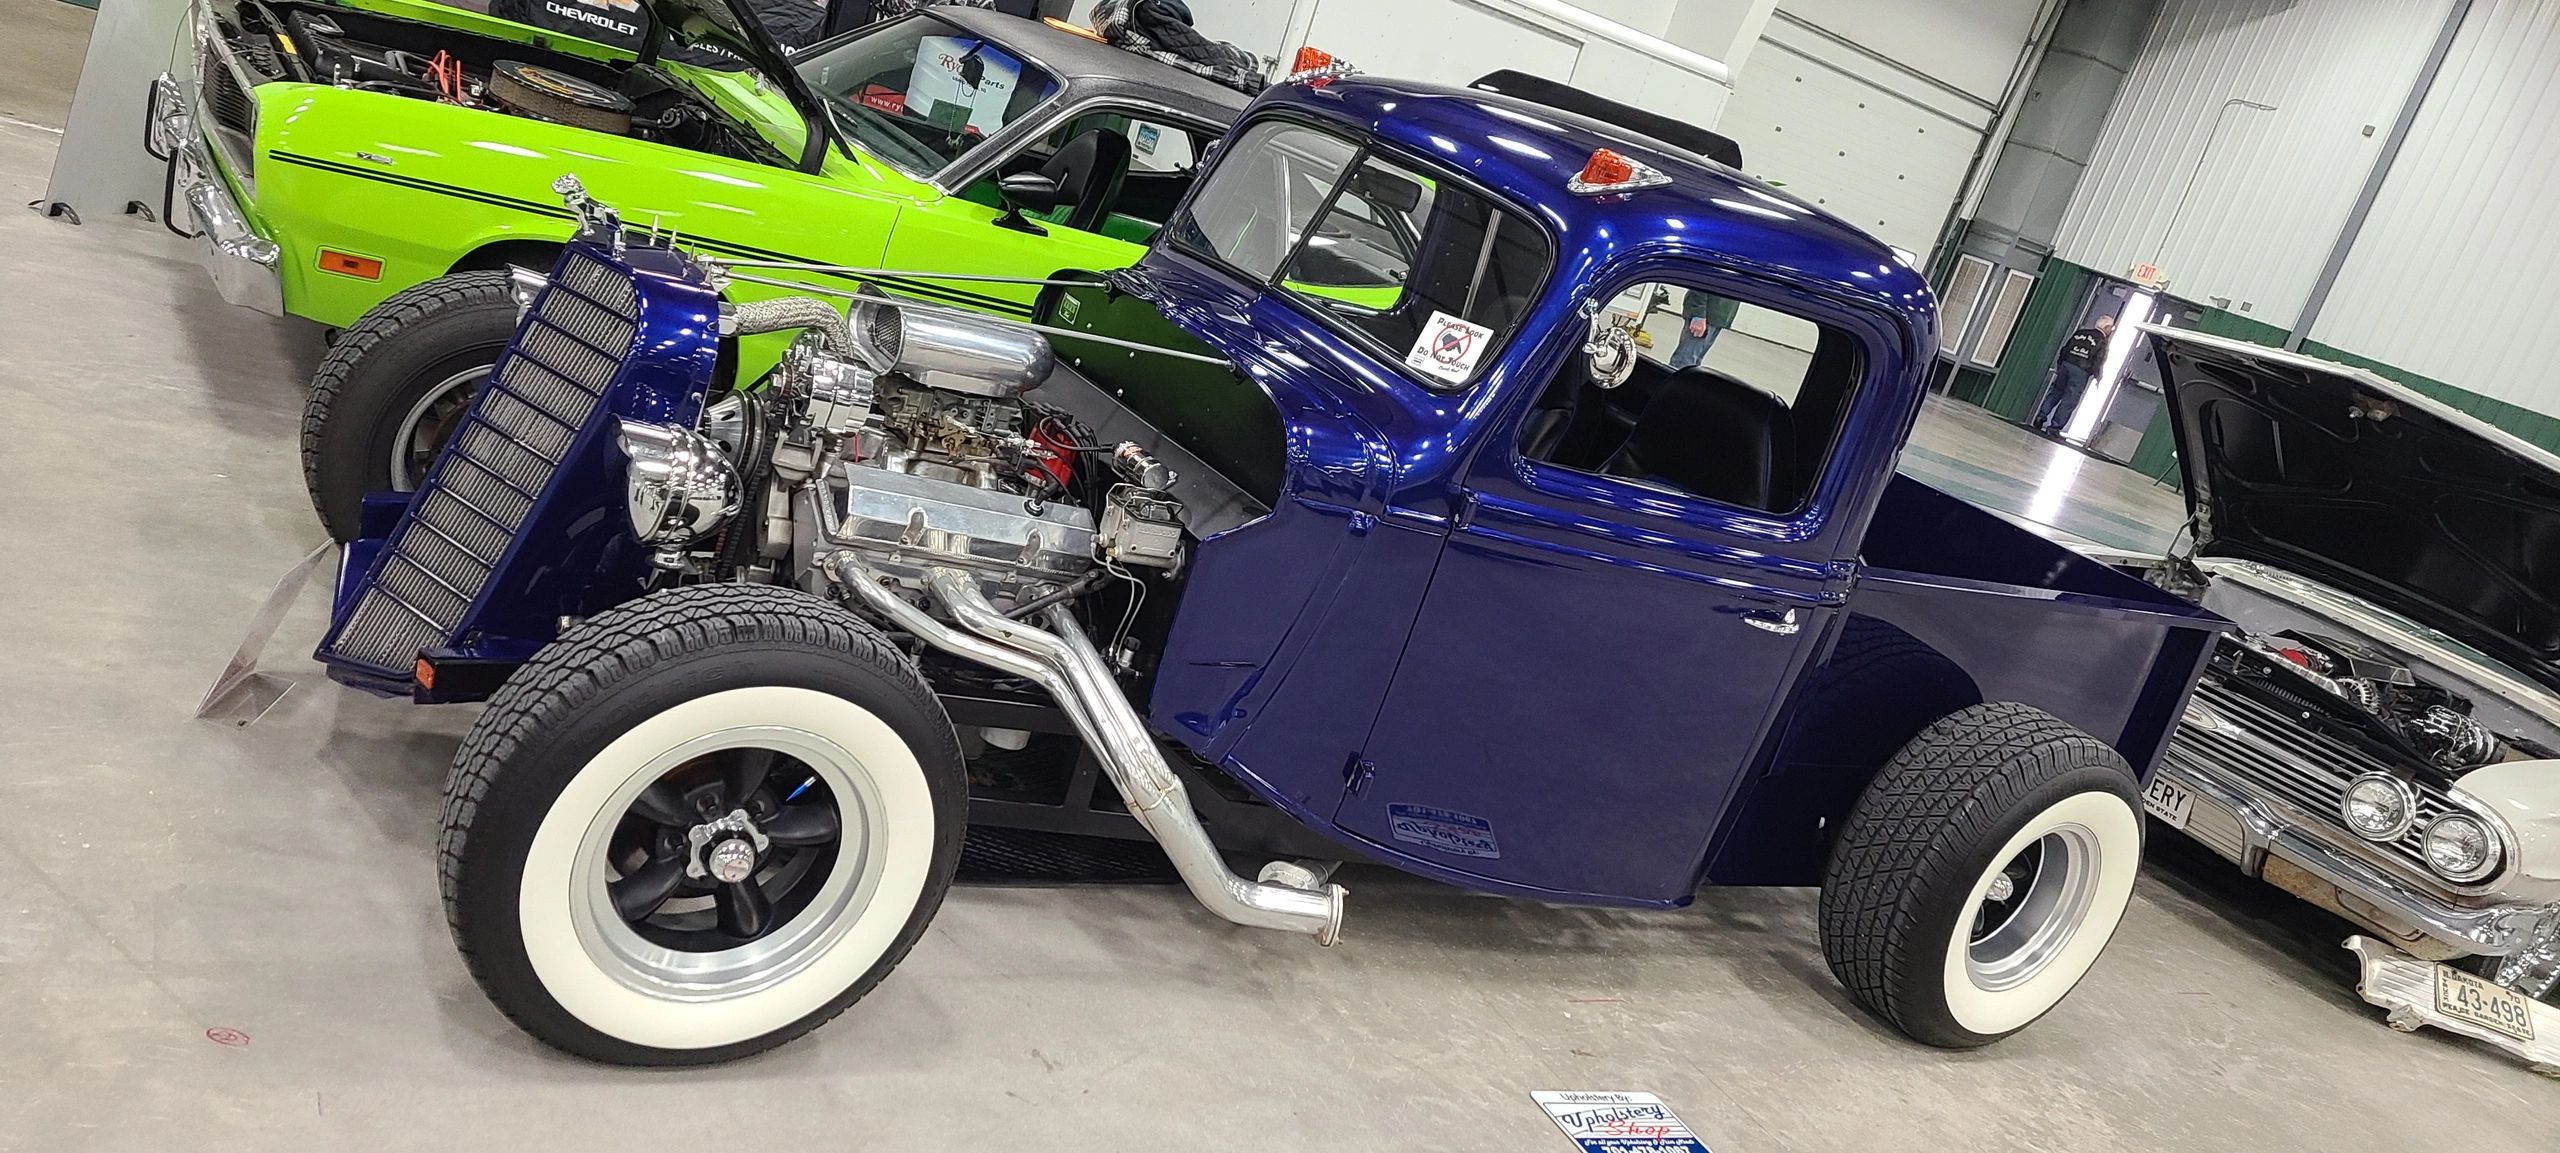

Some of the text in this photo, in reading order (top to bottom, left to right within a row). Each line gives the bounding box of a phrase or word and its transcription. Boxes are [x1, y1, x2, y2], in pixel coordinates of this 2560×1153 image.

[546, 1, 639, 36] CHEVROLET
[2137, 264, 2156, 280] EXIT
[1465, 326, 1484, 339] LOOK
[2155, 806, 2178, 821] STATE
[2451, 973, 2485, 991] DAKOTA
[2457, 984, 2527, 1028] 43-498
[1559, 1093, 1633, 1103] Upholstery By:
[1561, 1104, 1666, 1133] Upholstery
[1604, 1119, 1670, 1144] Shop
